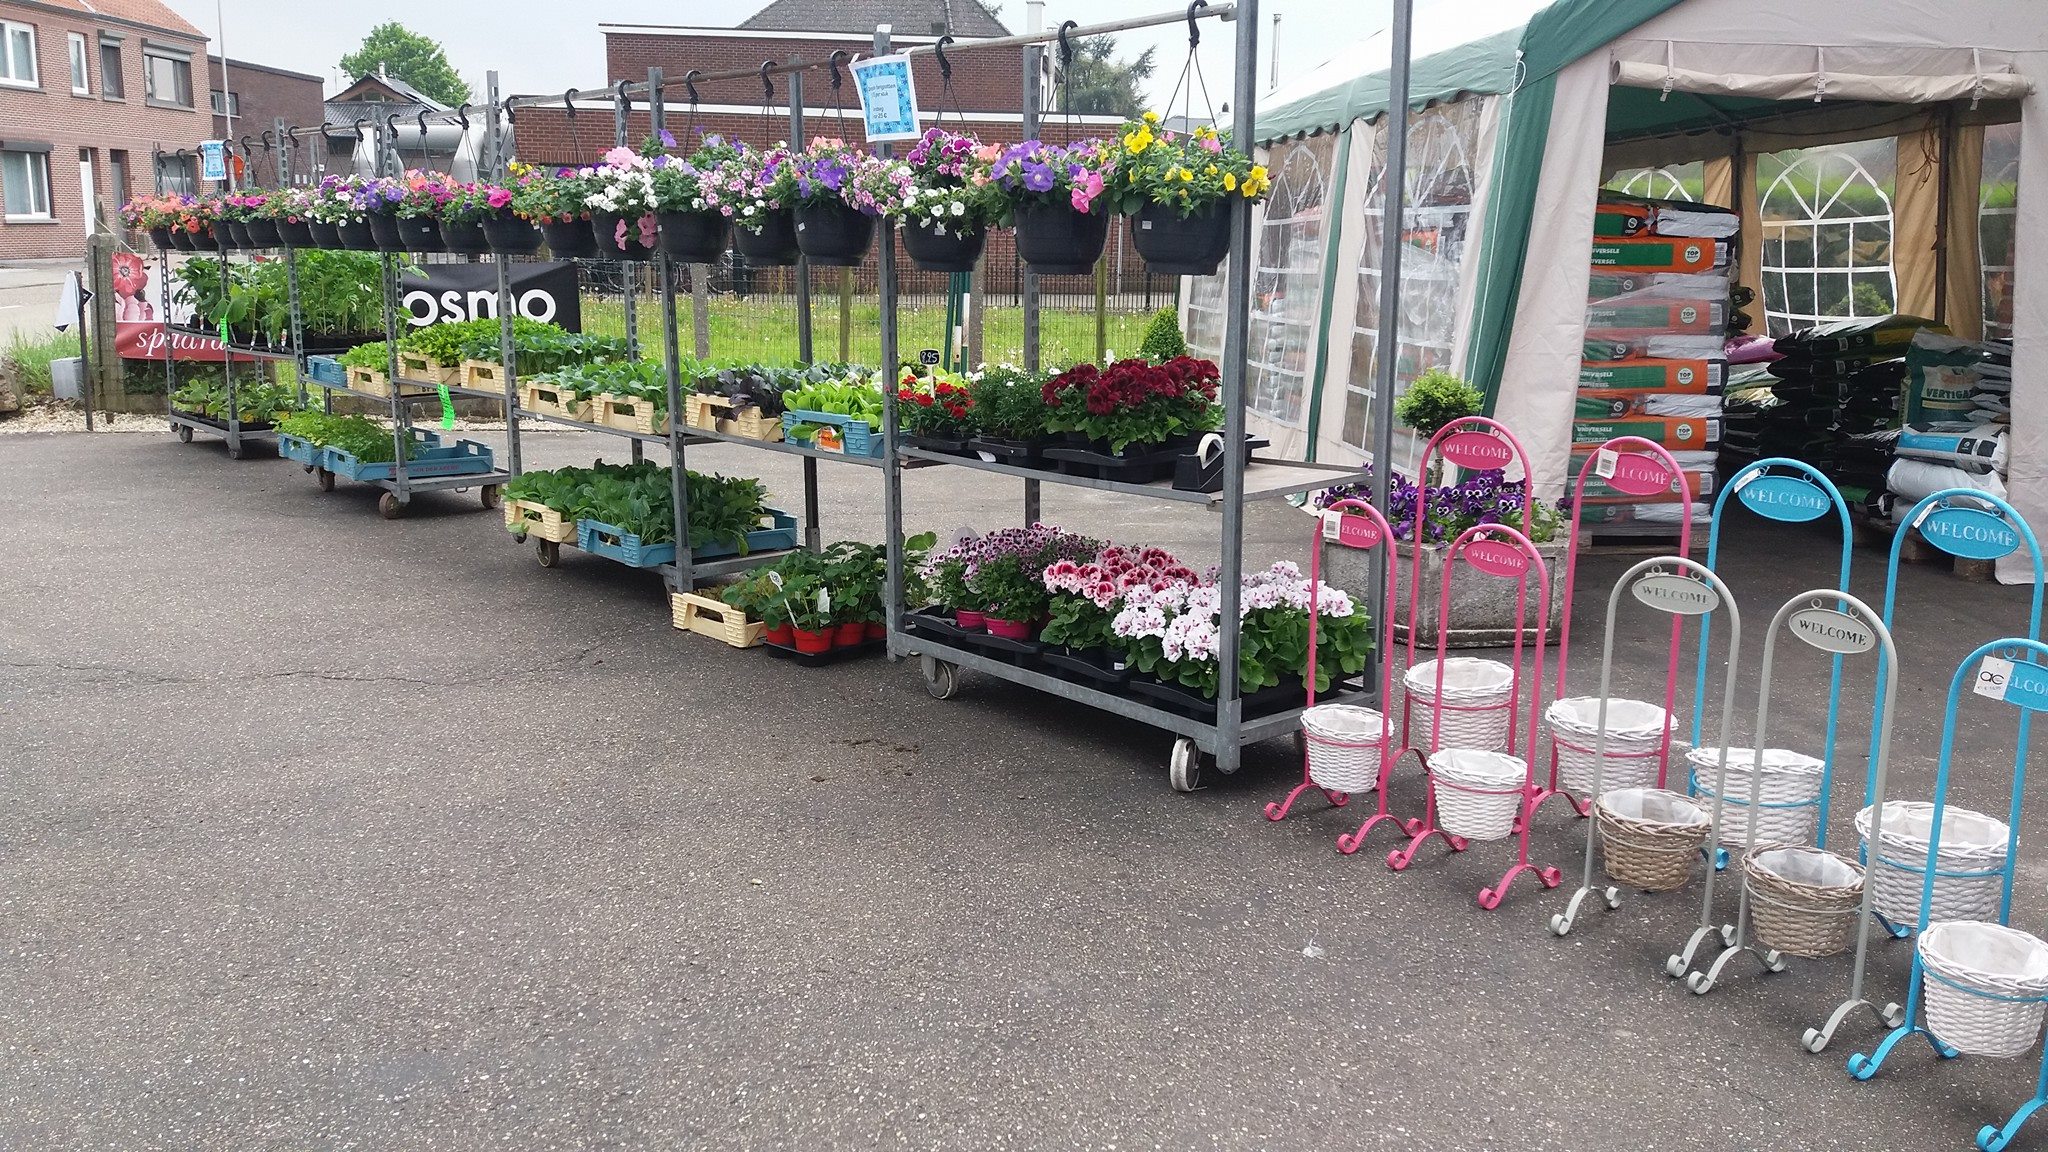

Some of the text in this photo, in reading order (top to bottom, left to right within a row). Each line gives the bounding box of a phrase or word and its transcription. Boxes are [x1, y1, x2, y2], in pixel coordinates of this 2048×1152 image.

[402, 289, 557, 327] osmo
[1926, 388, 1972, 399] VERTIGA
[1445, 444, 1510, 460] WELCOME
[1744, 489, 1827, 511] WELCOME
[1341, 524, 1378, 540] ELCOME
[1926, 520, 2015, 547] WELCOME
[1471, 549, 1524, 569] WELCOME
[1642, 586, 1709, 605] WELCOME
[1799, 620, 1867, 646] WELCOME
